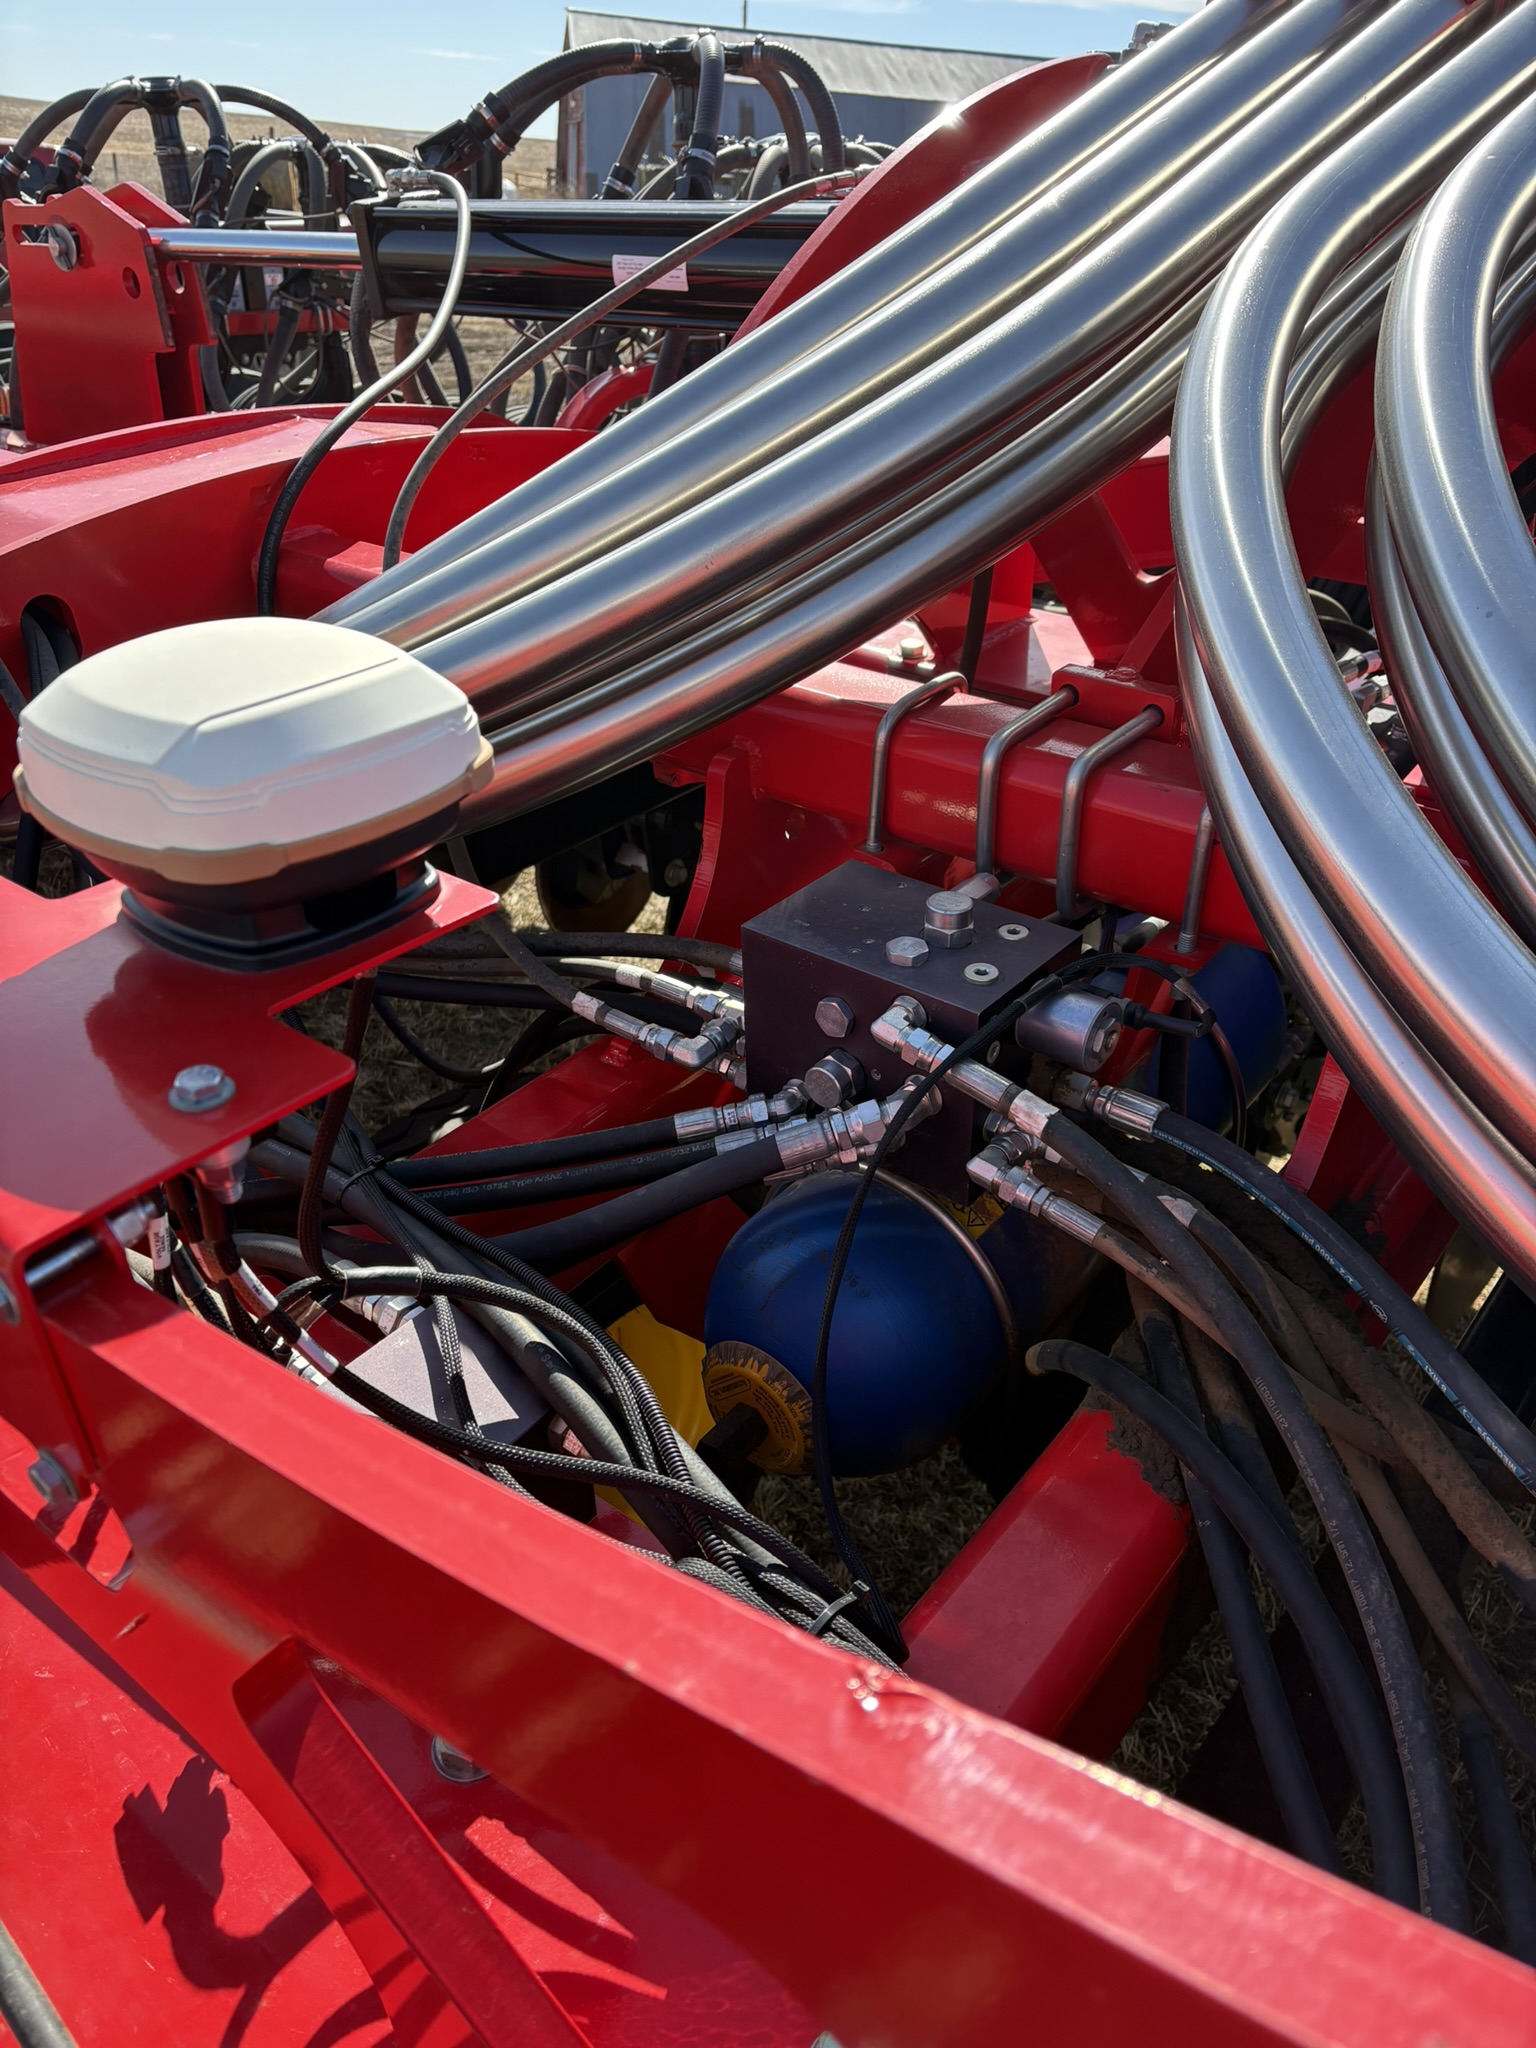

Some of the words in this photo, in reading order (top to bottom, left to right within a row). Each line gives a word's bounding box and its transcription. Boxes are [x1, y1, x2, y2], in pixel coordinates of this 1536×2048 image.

[1312, 1243, 1337, 1266] 4000
[1350, 1577, 1369, 1612] 100R17
[1362, 1614, 1377, 1635] SAE
[1387, 1689, 1400, 1715] MSHA
